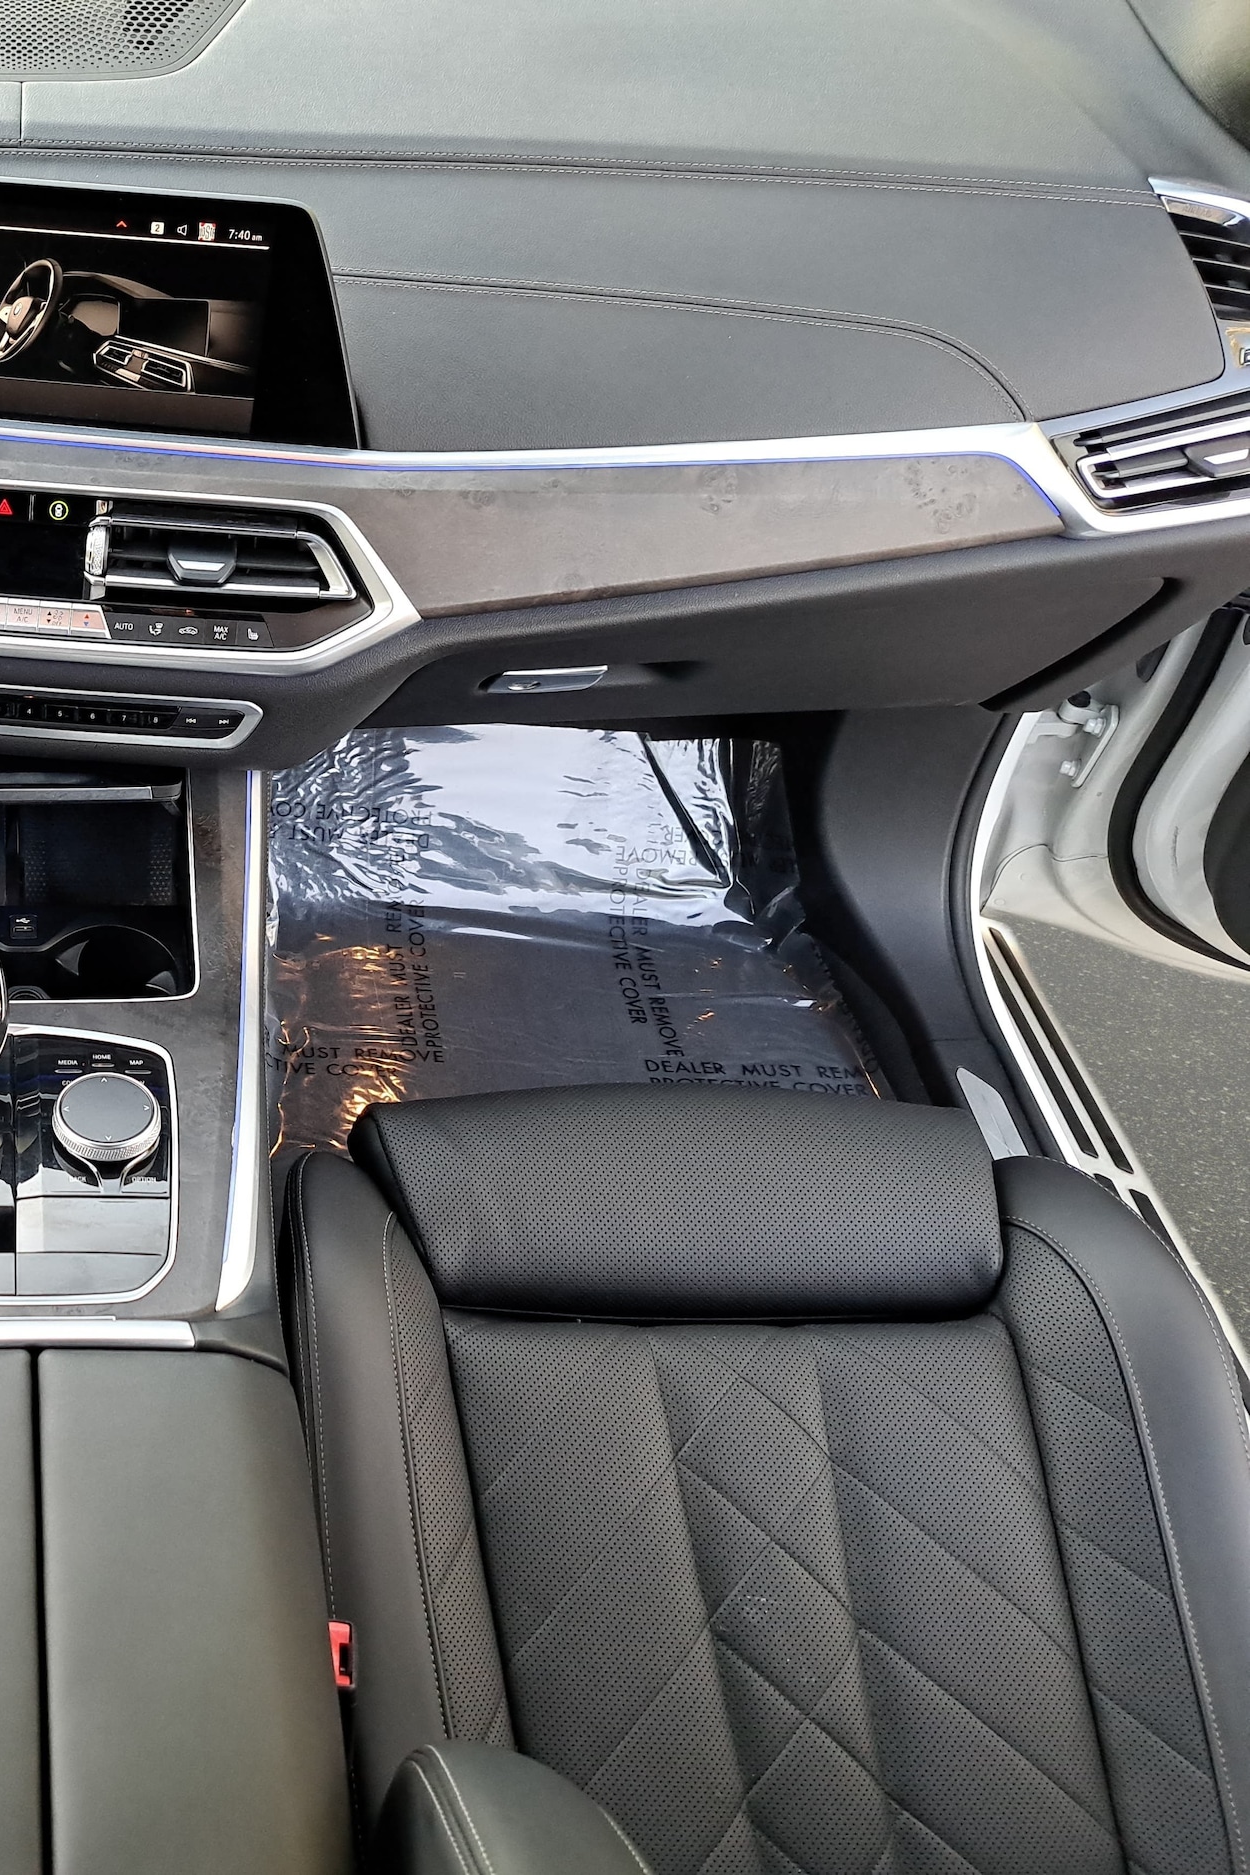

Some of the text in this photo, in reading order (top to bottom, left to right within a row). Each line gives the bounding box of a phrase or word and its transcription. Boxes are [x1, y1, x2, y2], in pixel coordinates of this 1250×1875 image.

[228, 229, 250, 240] 7:40
[13, 607, 32, 615] MENU
[114, 622, 134, 631] AUTO
[213, 625, 228, 635] MAX
[214, 632, 227, 641] A/C
[90, 712, 95, 720] 6
[631, 867, 685, 1057] DEALER MUST REMOVE
[408, 899, 443, 1048] PROTECTIVE COVER
[618, 977, 648, 1025] COVER
[394, 996, 418, 1047] DEALER
[645, 1060, 726, 1075] DEALER
[742, 1064, 801, 1077] MUST
